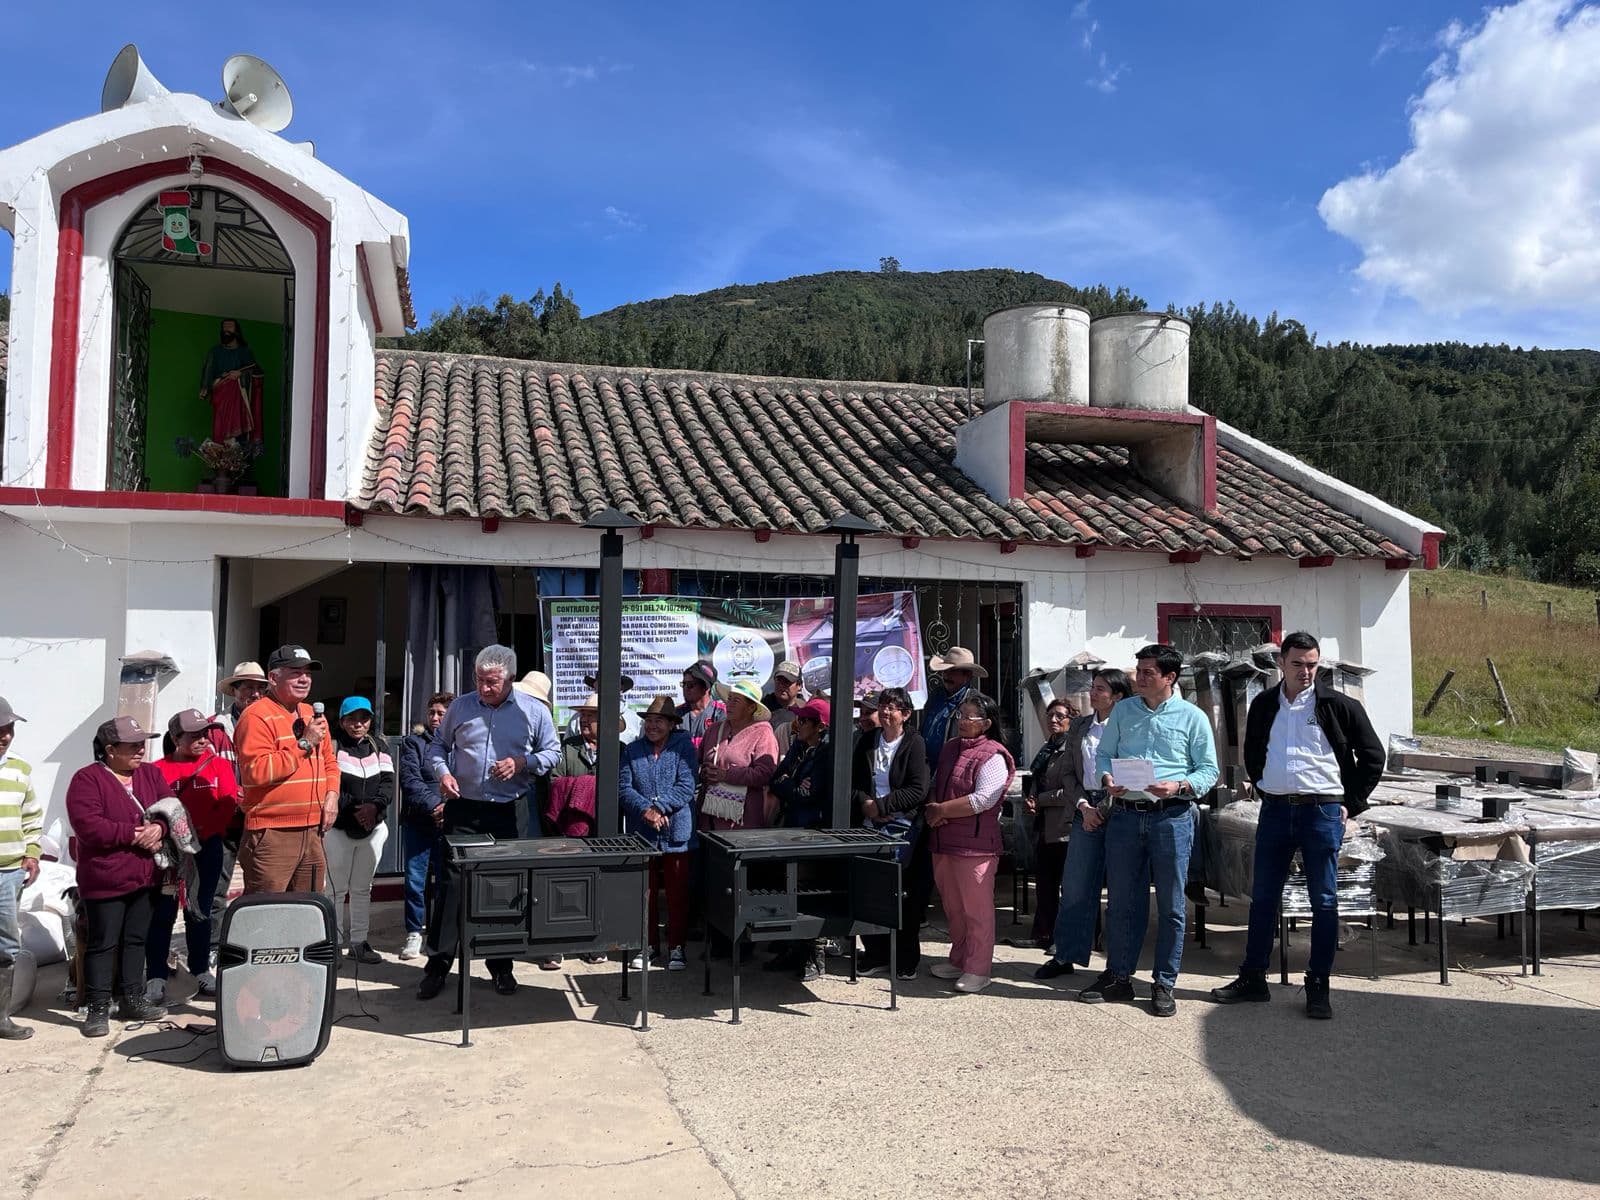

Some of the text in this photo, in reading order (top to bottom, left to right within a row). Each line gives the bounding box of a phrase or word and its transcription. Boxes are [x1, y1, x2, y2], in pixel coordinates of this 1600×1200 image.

[556, 605, 590, 613] CONTRATO
[644, 604, 655, 612] DEL
[253, 954, 299, 964] SOUND
